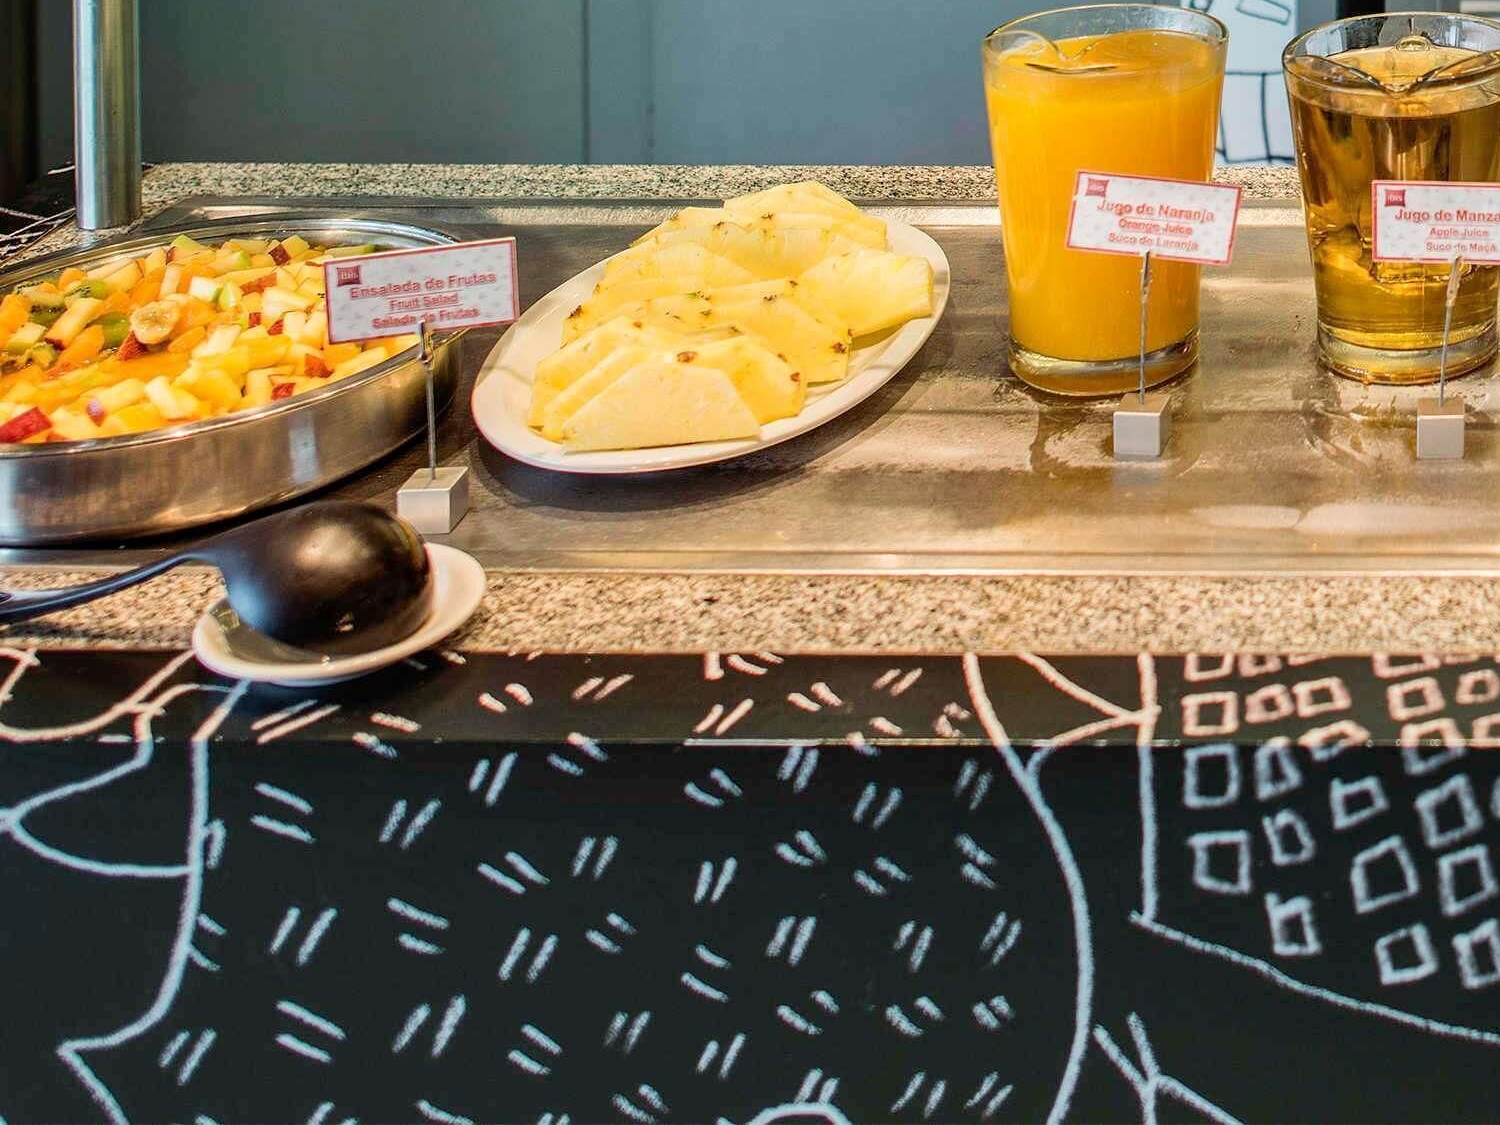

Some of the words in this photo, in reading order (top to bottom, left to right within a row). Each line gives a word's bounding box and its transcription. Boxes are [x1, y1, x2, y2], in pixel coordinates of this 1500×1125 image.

[1097, 200, 1133, 215] Jugo
[1136, 203, 1155, 214] de
[1158, 204, 1215, 224] Naranja
[1395, 210, 1430, 223] Jugo
[1434, 210, 1451, 221] de
[1118, 218, 1159, 233] Orange
[1162, 223, 1193, 235] Juice
[1429, 228, 1459, 238] Apple
[1462, 228, 1489, 237] Juice
[1138, 235, 1153, 245] de
[1156, 237, 1199, 251] Laranja
[1426, 242, 1451, 251] Suco
[350, 281, 421, 299] Ensalada
[426, 277, 445, 290] de
[448, 272, 497, 287] Frutas
[389, 297, 420, 311] Fruit
[423, 293, 459, 306] Salad
[439, 307, 480, 322] Frutas
